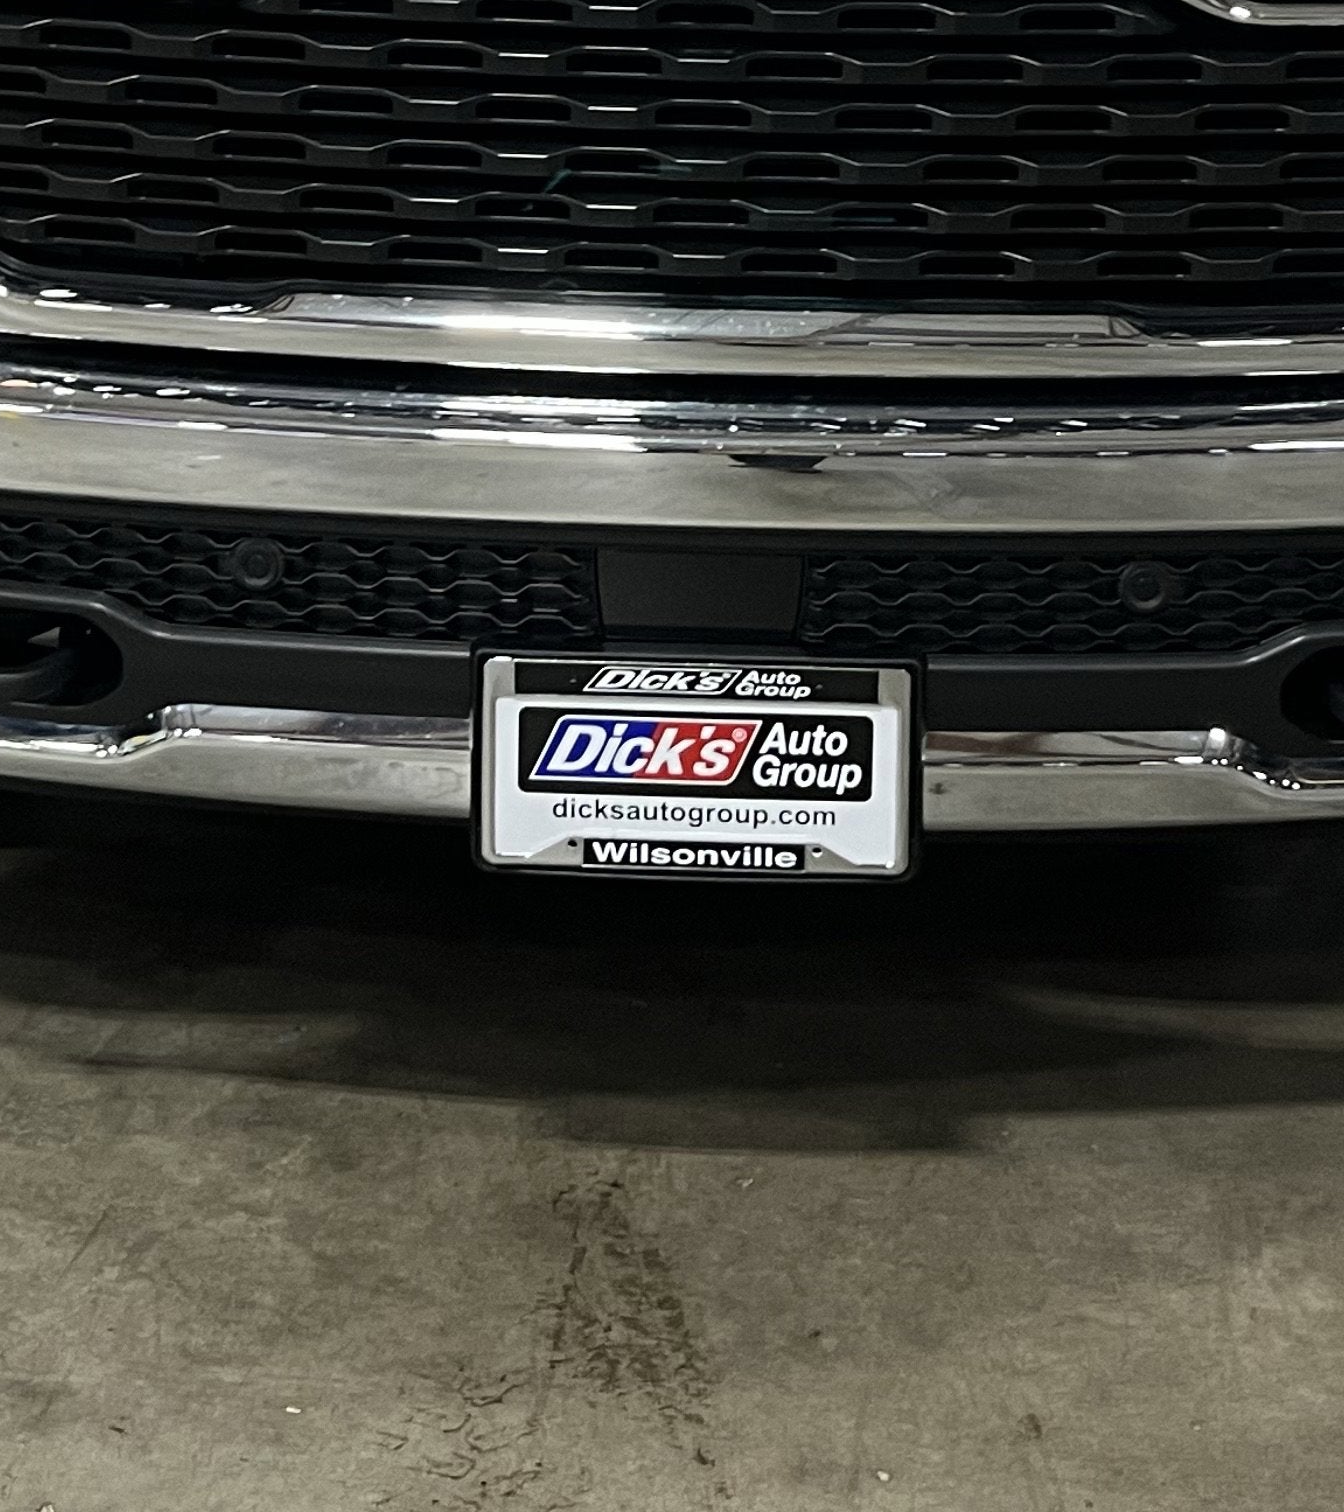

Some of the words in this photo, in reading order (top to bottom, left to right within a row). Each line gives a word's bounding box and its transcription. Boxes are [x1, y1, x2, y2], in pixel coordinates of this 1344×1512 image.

[735, 682, 812, 700] Group
[742, 670, 802, 686] Auto
[758, 721, 848, 757] Auto
[752, 754, 862, 796] Group
[552, 798, 837, 828] dicksautogroup.com
[591, 841, 798, 869] Wilsonville
